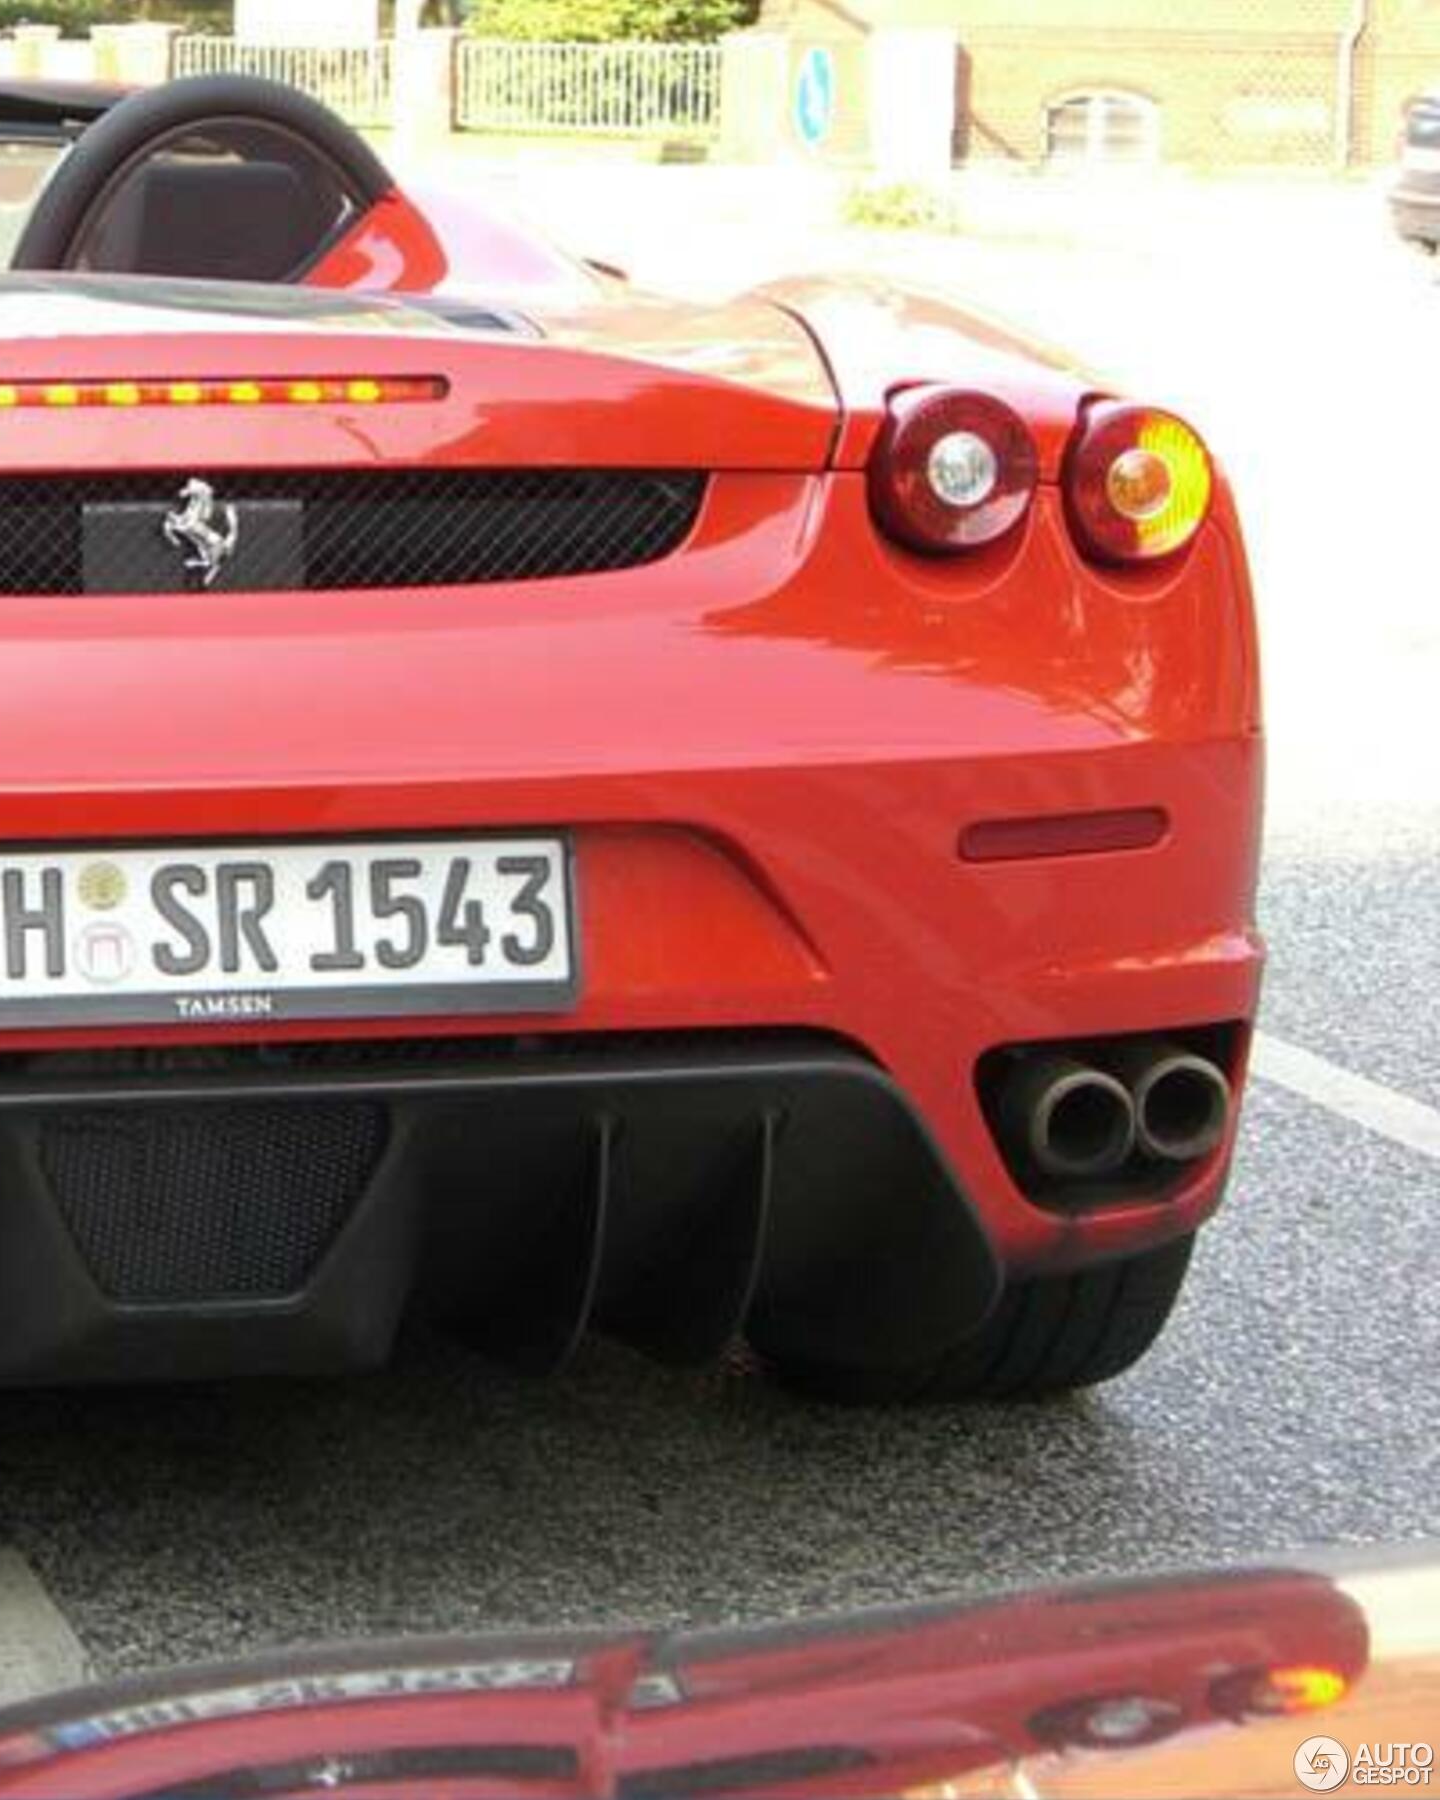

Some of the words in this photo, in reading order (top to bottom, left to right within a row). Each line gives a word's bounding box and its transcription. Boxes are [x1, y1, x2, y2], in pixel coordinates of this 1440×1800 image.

[150, 860, 279, 976] SR
[305, 855, 555, 972] 1543
[174, 995, 272, 1017] TAMSEN
